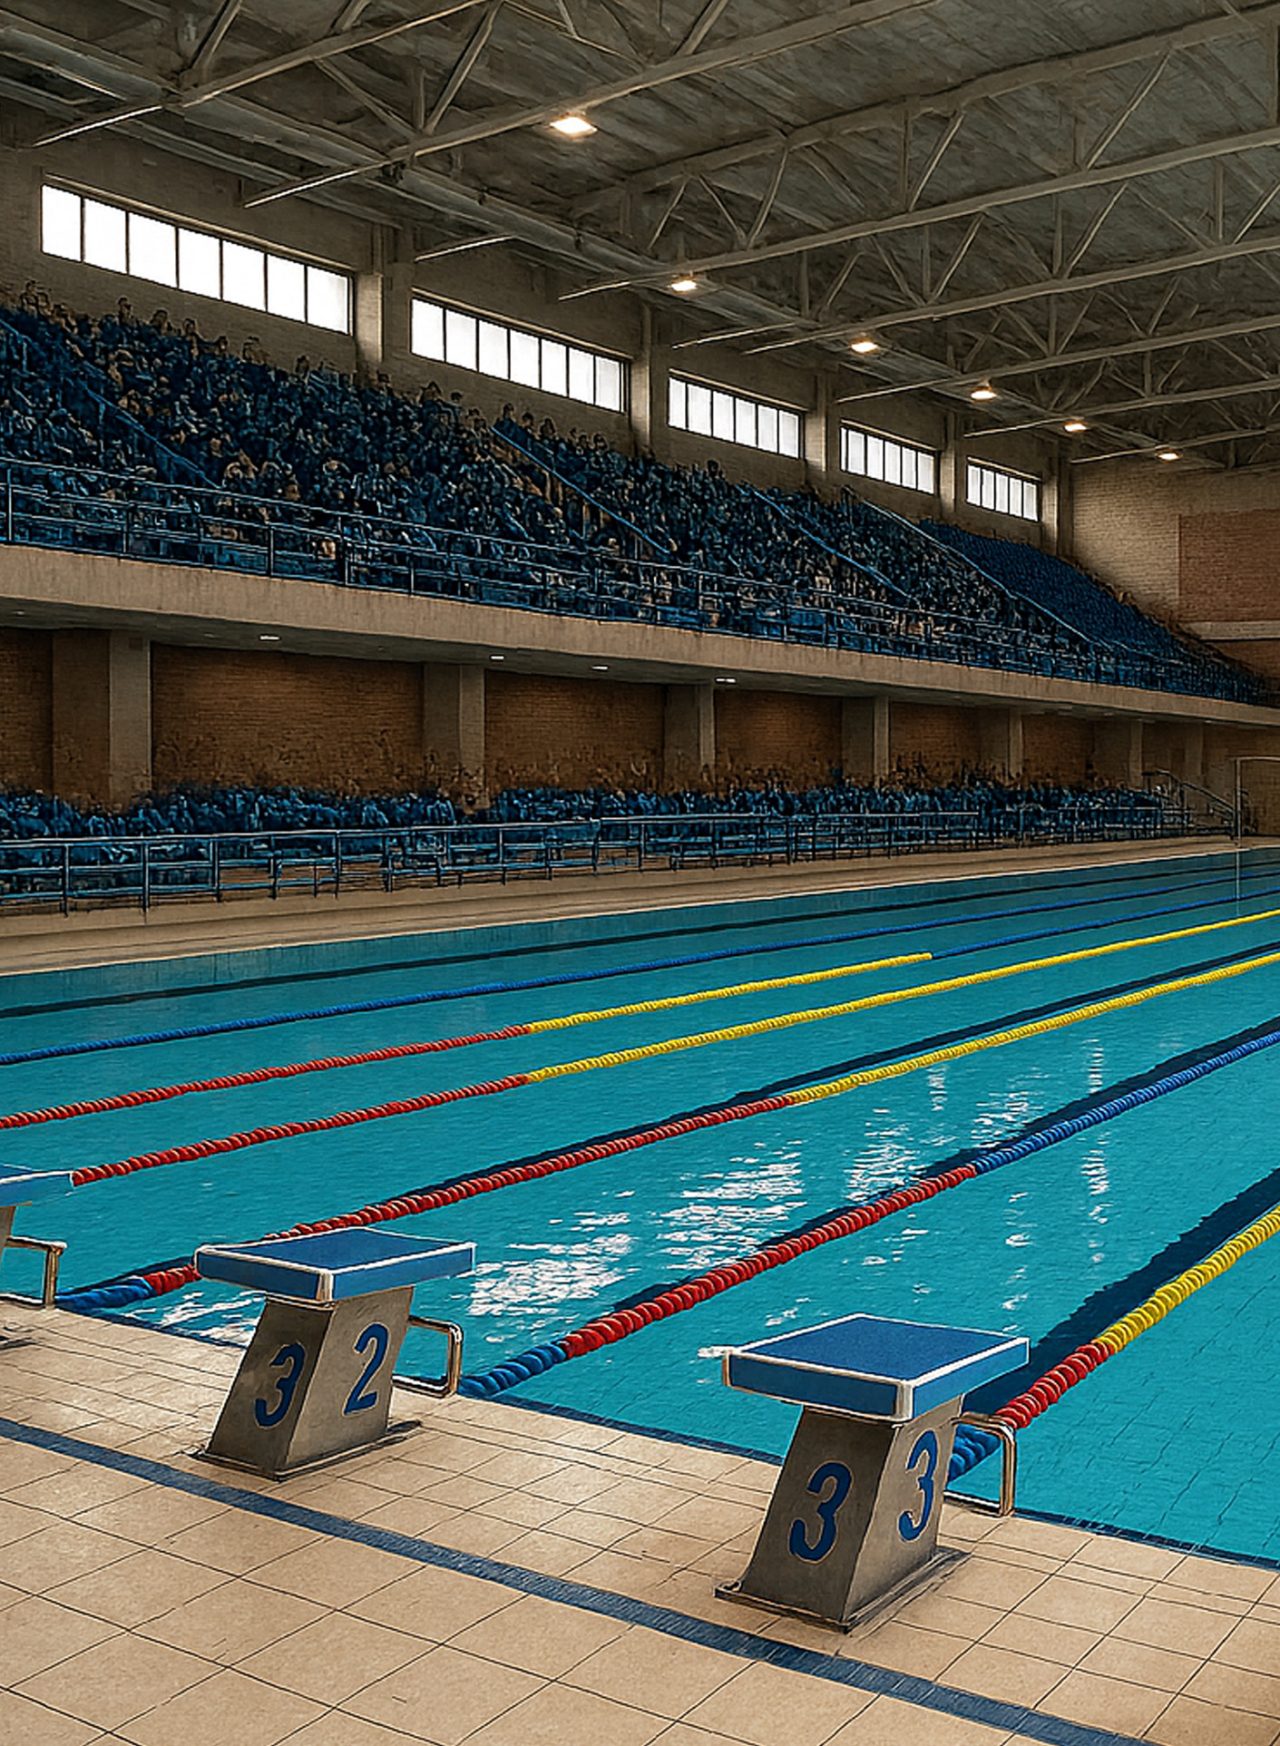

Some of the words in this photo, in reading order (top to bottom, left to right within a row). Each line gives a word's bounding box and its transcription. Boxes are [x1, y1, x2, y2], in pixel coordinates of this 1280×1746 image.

[255, 1342, 306, 1427] 3
[343, 1323, 389, 1415] 2
[789, 1462, 851, 1562] 3
[899, 1430, 938, 1541] 3
